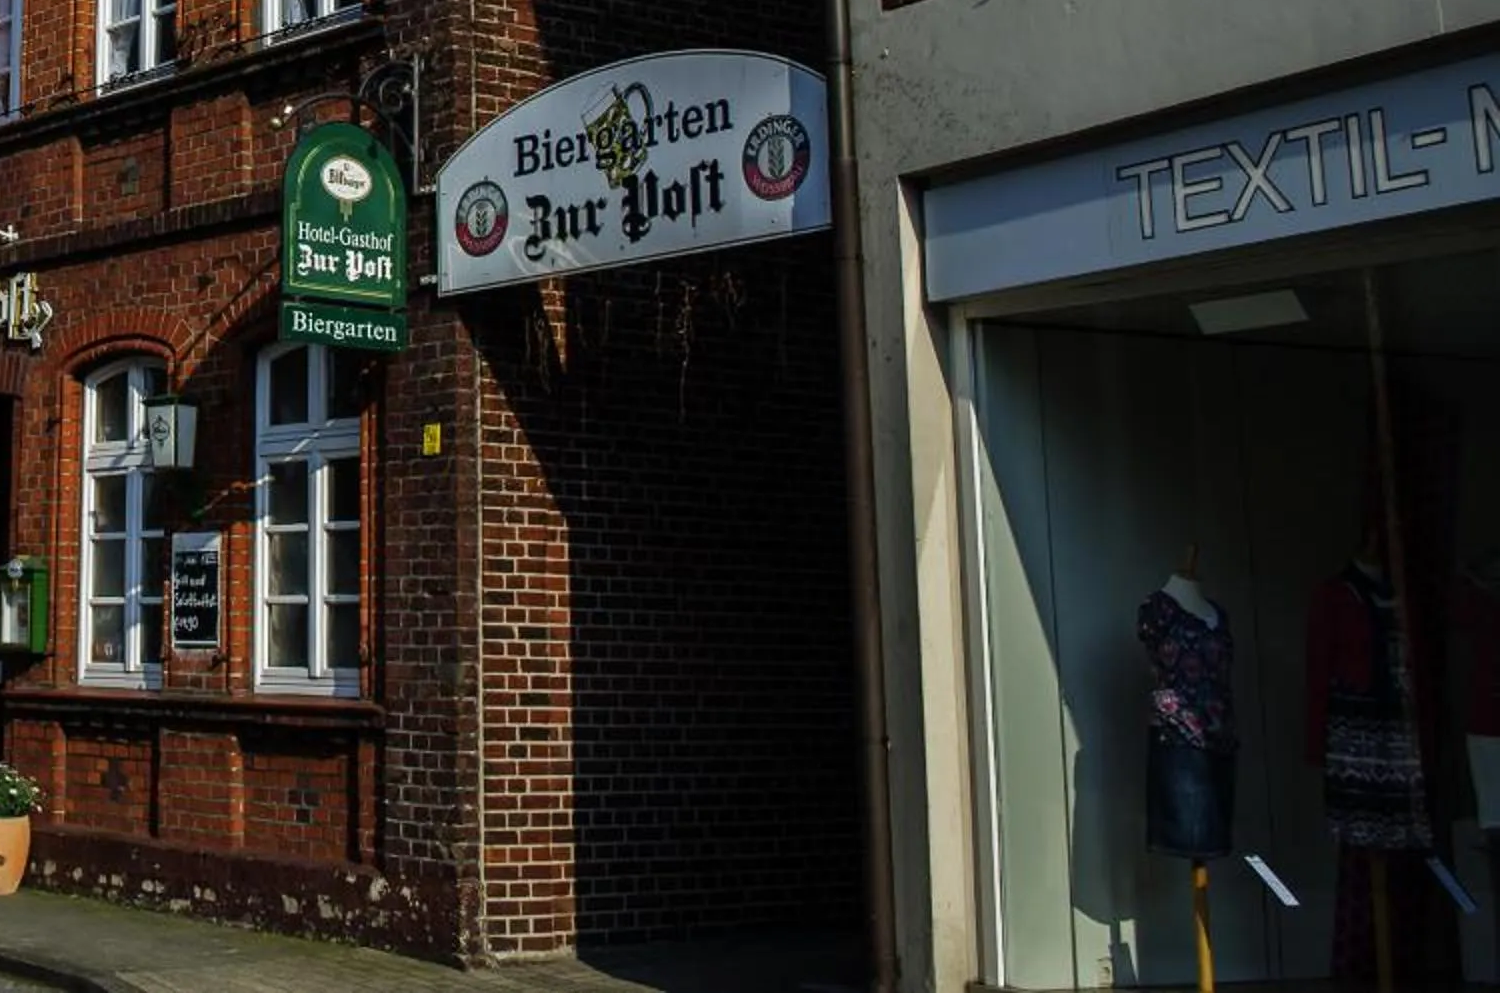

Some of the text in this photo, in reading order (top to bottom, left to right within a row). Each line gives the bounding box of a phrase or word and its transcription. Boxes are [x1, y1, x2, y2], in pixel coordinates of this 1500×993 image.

[513, 98, 734, 178] Biergarten
[524, 194, 607, 261] Zur
[622, 158, 726, 244] Post
[297, 220, 395, 252] Hotel-Gasthof
[297, 242, 393, 282] Zur Post
[292, 309, 398, 342] Biergarten
